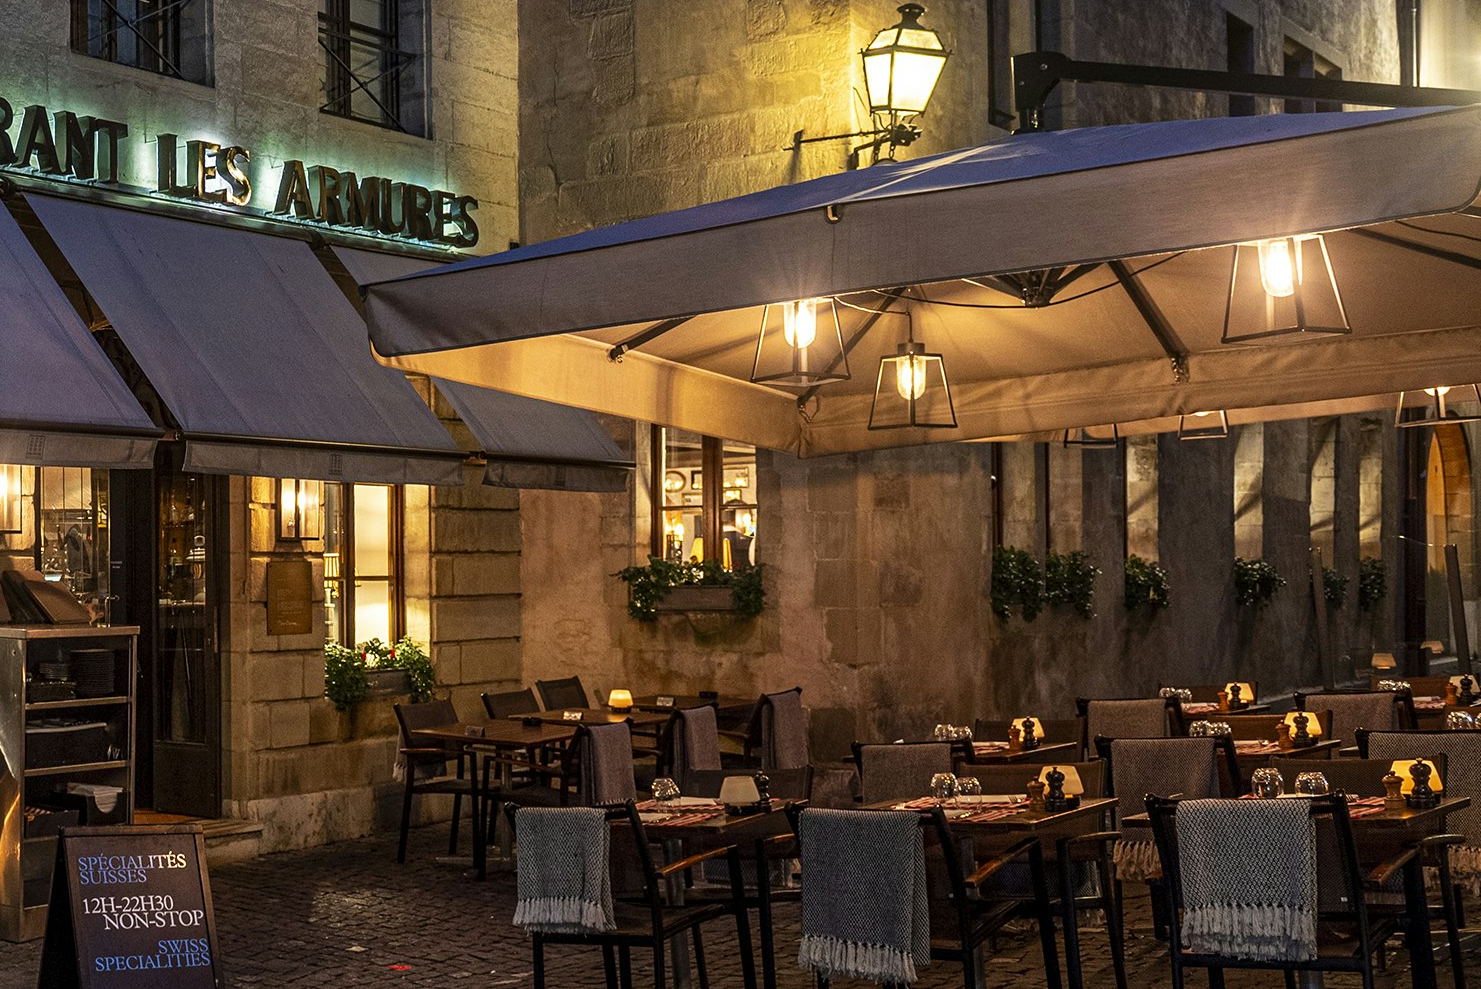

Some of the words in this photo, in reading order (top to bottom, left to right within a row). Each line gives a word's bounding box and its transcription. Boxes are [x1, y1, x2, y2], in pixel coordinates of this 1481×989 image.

[155, 133, 250, 207] LES
[270, 160, 479, 247] ARMURES
[78, 851, 187, 871] SPÉCIALITÉS
[79, 869, 147, 885] SUISSES
[82, 895, 174, 914] 12H-22H30
[103, 909, 204, 930] NON-STOP
[158, 938, 209, 955] SWISS
[95, 952, 211, 972] SPECIALITIES
